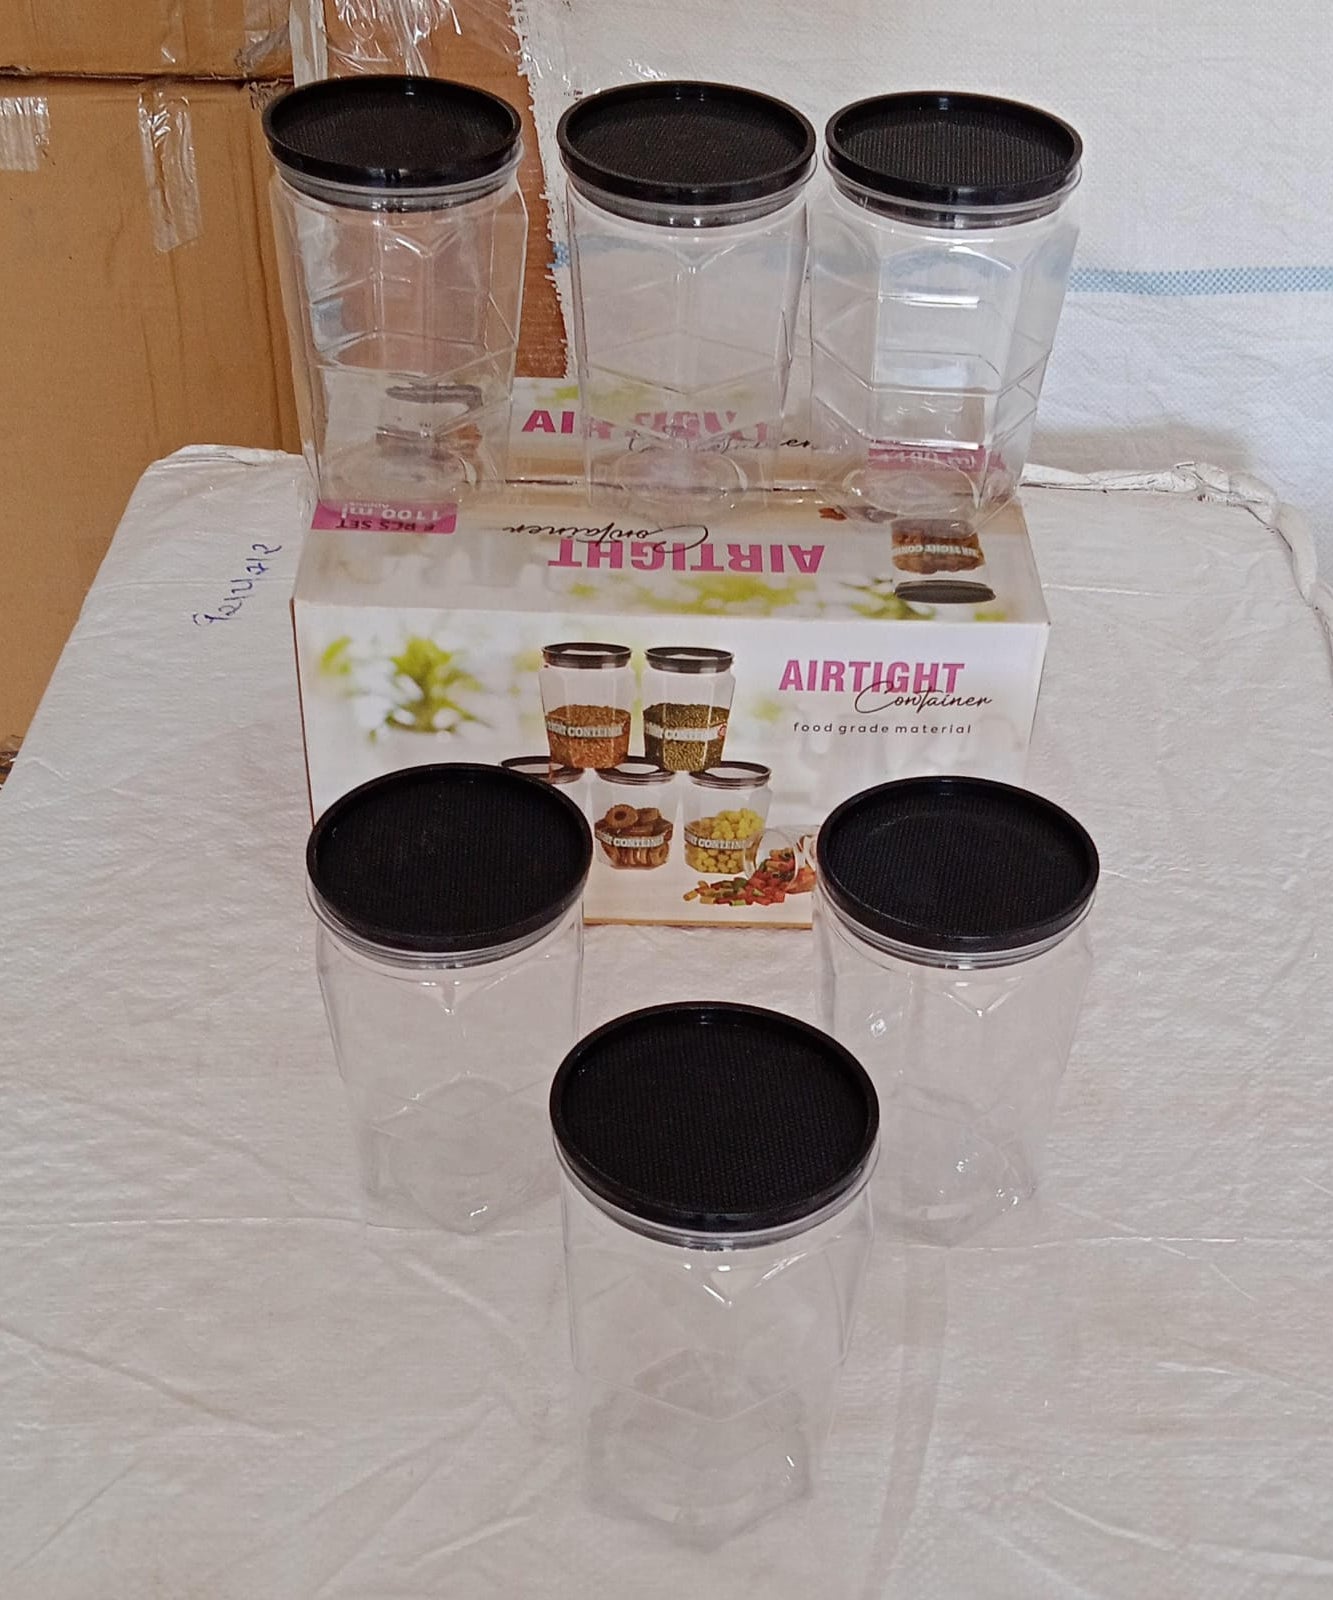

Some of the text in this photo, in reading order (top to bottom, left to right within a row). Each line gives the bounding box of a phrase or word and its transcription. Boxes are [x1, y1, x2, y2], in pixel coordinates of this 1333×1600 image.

[335, 518, 373, 530] SET
[379, 518, 416, 531] PCS
[382, 508, 440, 520] 1100
[502, 523, 709, 554] Container
[547, 539, 826, 574] AIRTIGHT
[779, 659, 965, 694] AIRTIGHT
[855, 681, 993, 715] Container
[794, 721, 972, 735] food grade material
